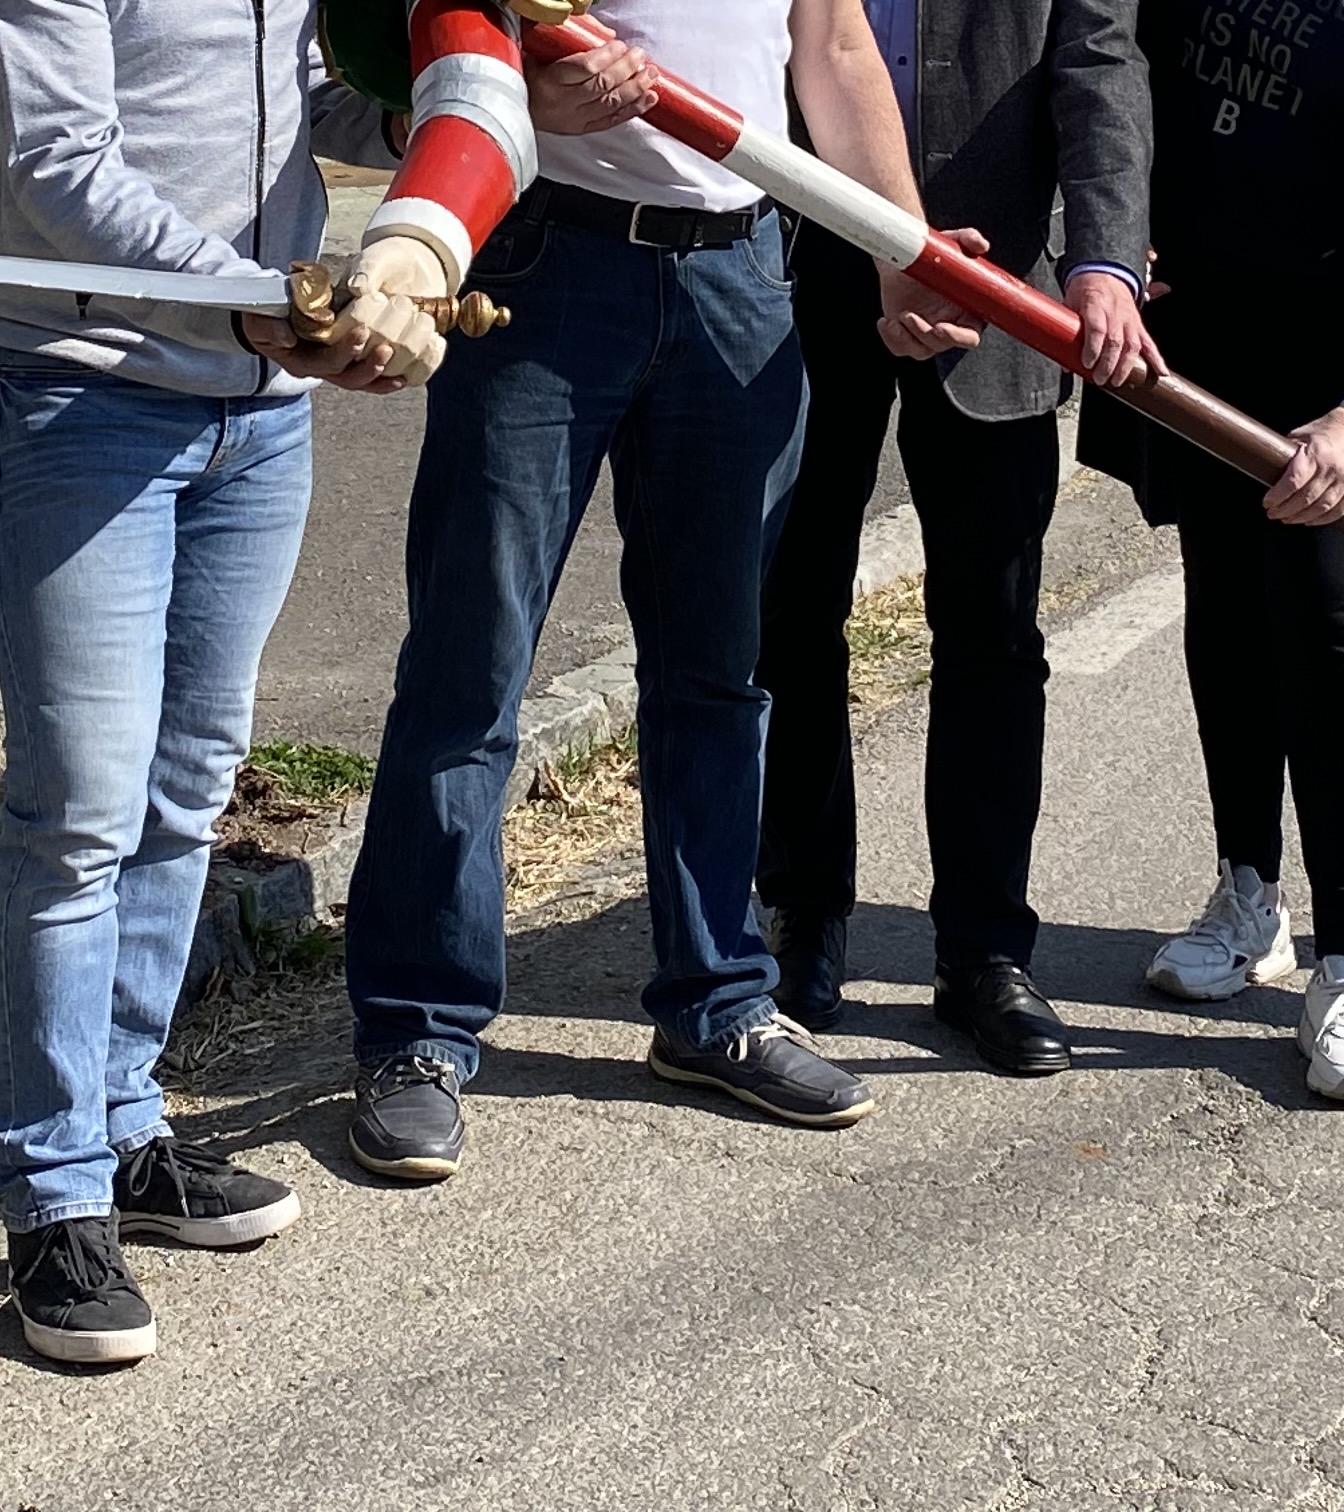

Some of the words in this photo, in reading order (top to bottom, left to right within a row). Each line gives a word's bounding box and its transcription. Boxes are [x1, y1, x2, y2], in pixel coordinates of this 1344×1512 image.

[1200, 4, 1235, 46] IS
[1248, 28, 1292, 74] NO
[1181, 37, 1304, 117] PLANET
[1212, 98, 1240, 135] B
